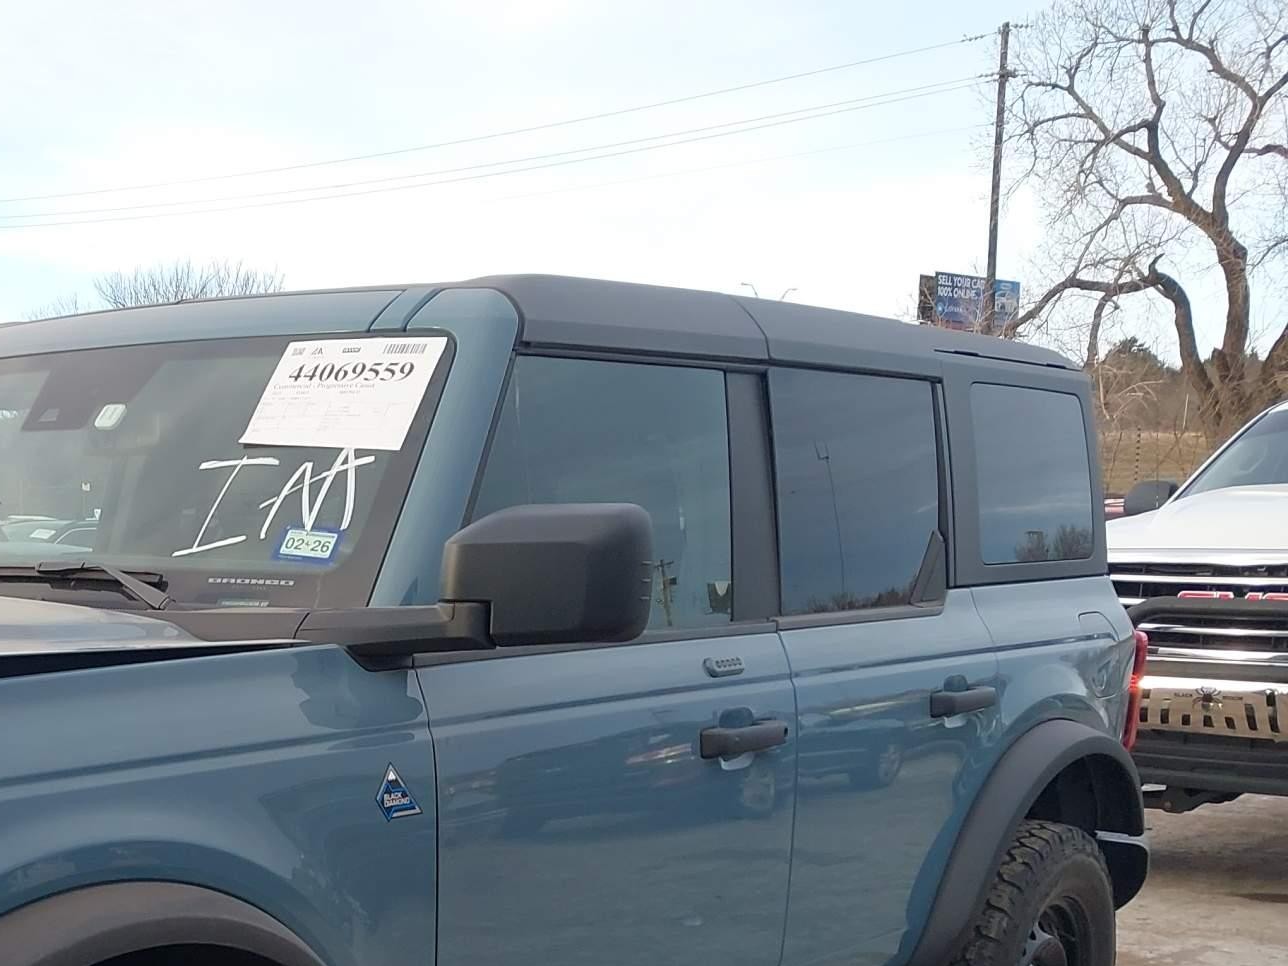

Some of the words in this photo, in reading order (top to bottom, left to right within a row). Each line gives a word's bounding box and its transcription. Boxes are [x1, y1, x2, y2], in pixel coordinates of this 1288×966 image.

[938, 275, 952, 286] SELL
[953, 276, 971, 289] YOUR
[937, 285, 953, 297] 100%
[289, 361, 415, 382] 44069559
